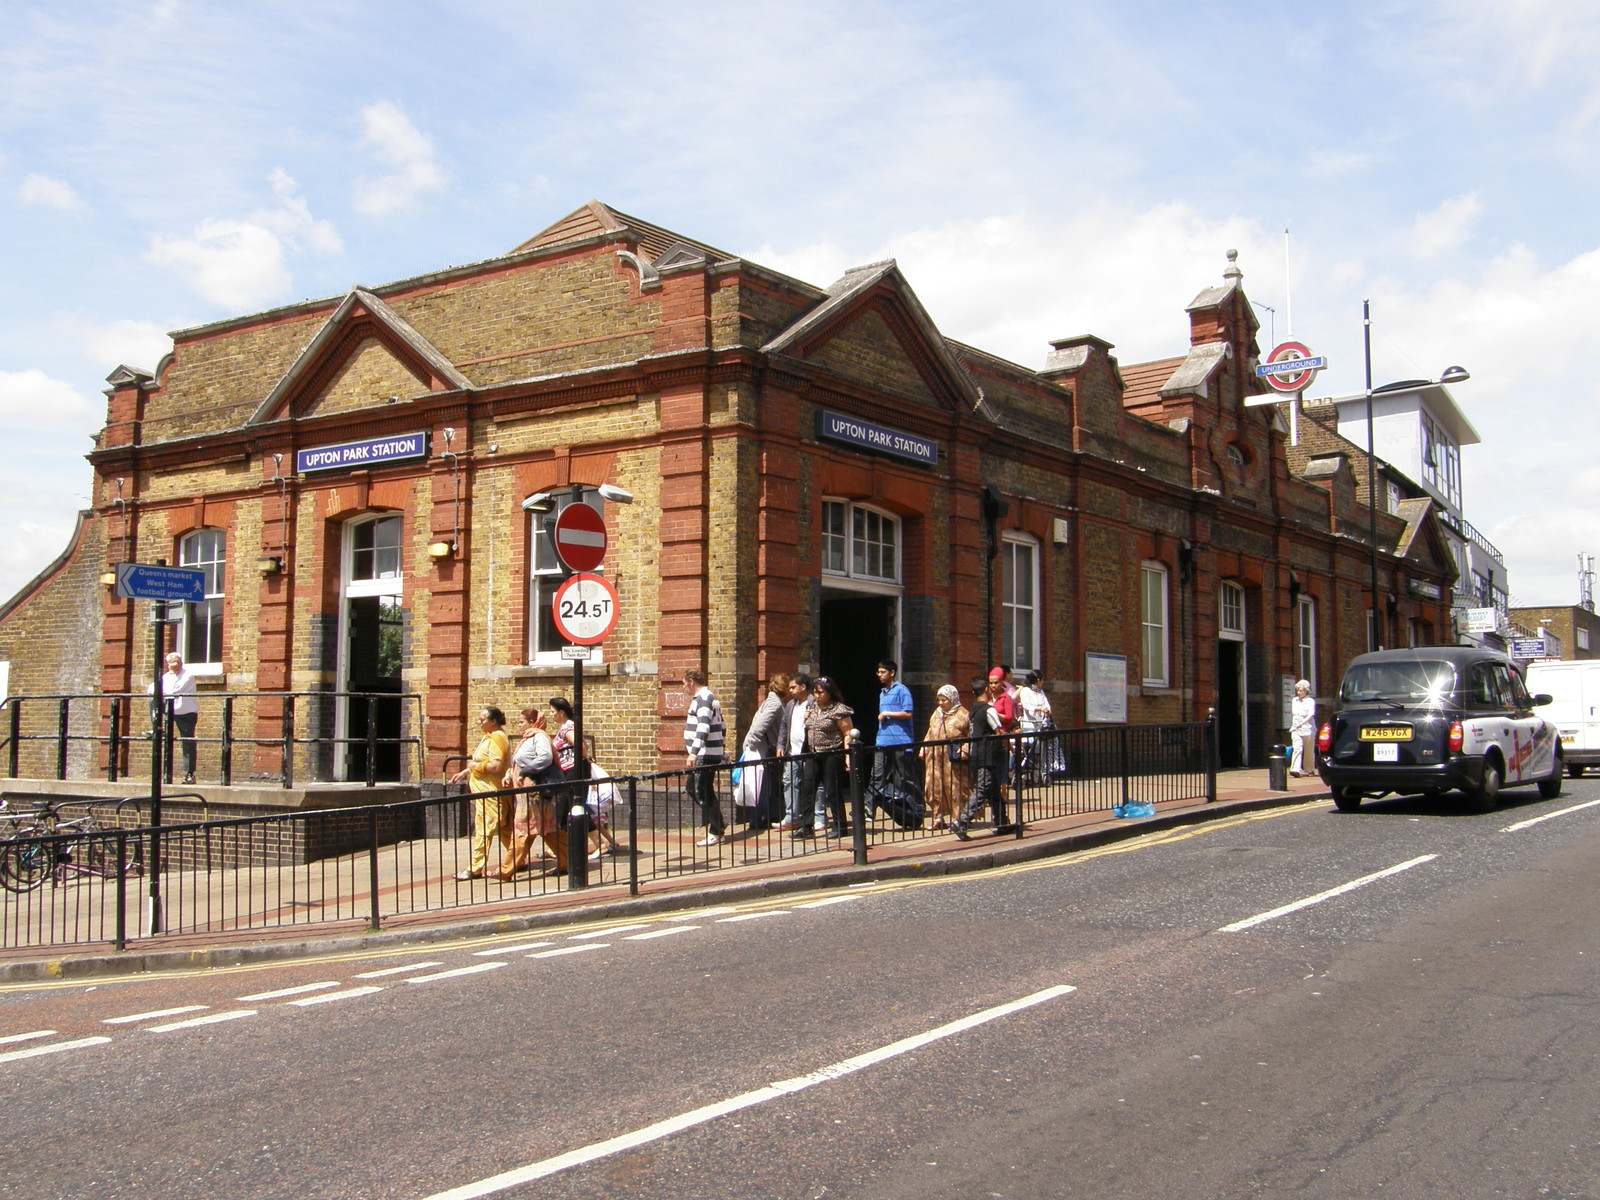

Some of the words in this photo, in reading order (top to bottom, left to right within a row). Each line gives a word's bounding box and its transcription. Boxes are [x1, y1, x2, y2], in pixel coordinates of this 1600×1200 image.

[1261, 359, 1317, 373] UNDERGROUND
[832, 419, 866, 440] UPTON
[868, 429, 892, 447] PARK
[894, 436, 930, 458] STATION
[306, 450, 340, 467] UPTON
[343, 446, 369, 461] PARK
[372, 439, 416, 457] STATION
[138, 568, 167, 578] Queen's
[146, 579, 165, 587] West
[167, 581, 184, 589] Ham
[136, 587, 165, 596] football
